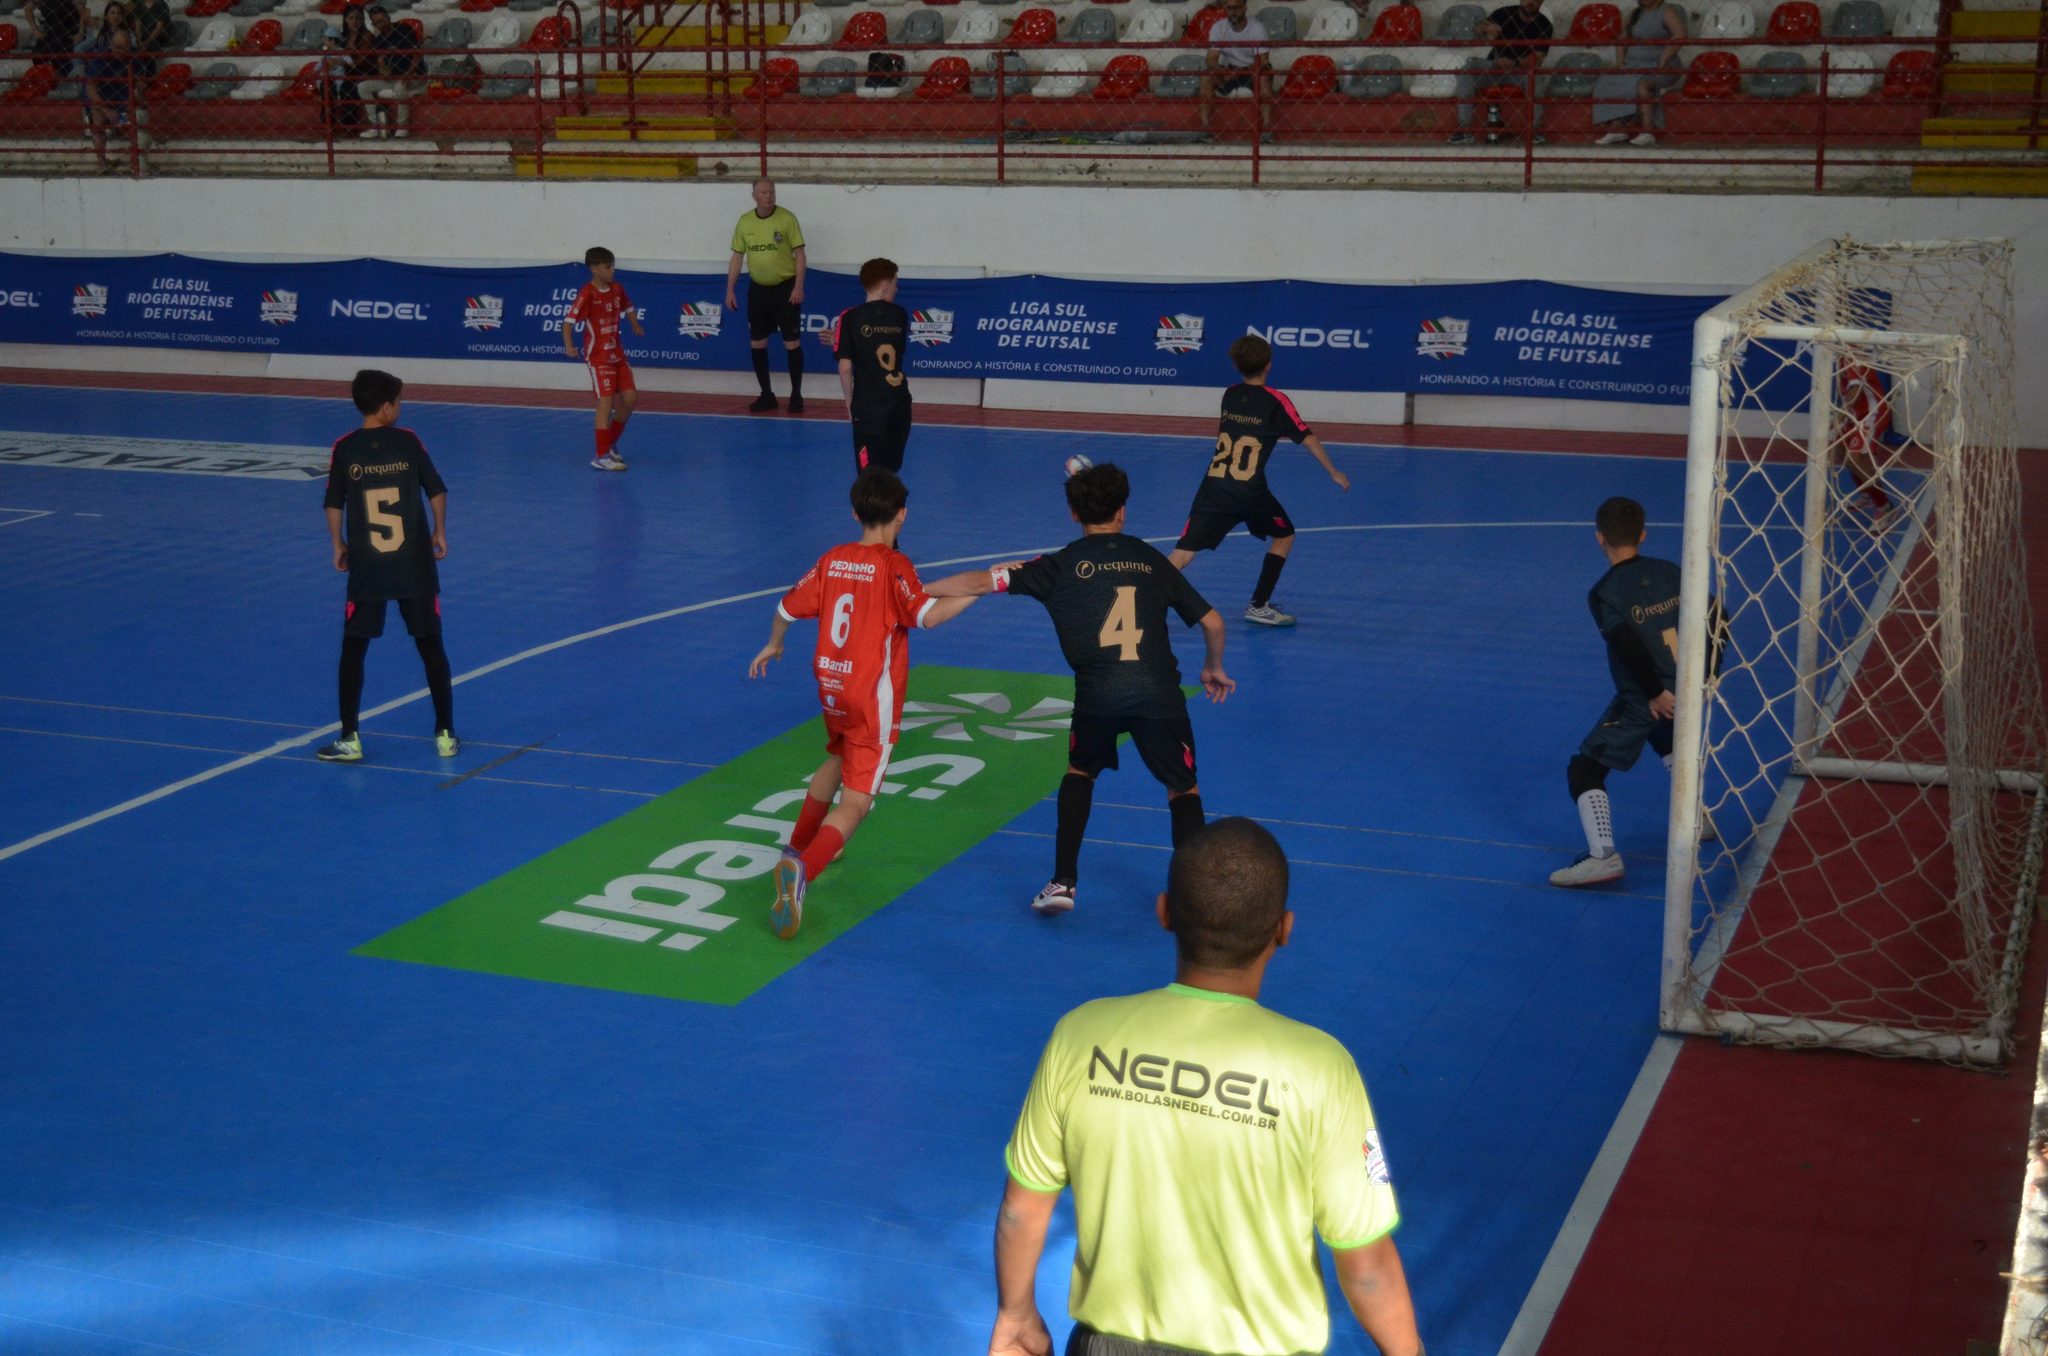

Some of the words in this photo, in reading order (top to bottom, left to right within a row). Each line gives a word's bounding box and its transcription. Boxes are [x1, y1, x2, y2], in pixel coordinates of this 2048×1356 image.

[153, 278, 184, 291] LIGA
[186, 280, 210, 292] SUL
[127, 292, 234, 308] RIOGRANDENSE
[553, 288, 578, 301] LIG
[144, 308, 162, 319] DE
[164, 309, 214, 321] FUTSAL
[331, 299, 428, 321] NEDEL
[1010, 302, 1050, 315] LIGA
[1054, 304, 1087, 317] SUL
[543, 319, 562, 332] DE
[977, 318, 1118, 335] RIOGRANDENSE
[1531, 309, 1576, 327] LIGA
[1581, 314, 1618, 330] SUL
[77, 330, 124, 339] HONRANDO
[126, 331, 132, 339] A
[134, 330, 170, 340] HISTÓRIA
[171, 332, 177, 340] E
[178, 332, 236, 344] CONSTRUINDO
[238, 336, 245, 344] O
[247, 336, 280, 345] FUTURO
[998, 334, 1022, 347] DE
[1024, 335, 1090, 350] FUTSAL
[1246, 325, 1370, 348] NEDEL
[1494, 327, 1653, 348] RIOGRANDENSE
[468, 344, 521, 353] HONRANDO
[651, 350, 659, 359] O
[662, 350, 700, 361] FUTURO
[1518, 346, 1545, 361] DE
[1548, 349, 1622, 365] FUTSAL
[876, 344, 904, 387] 9
[913, 359, 973, 370] HONRANDO
[975, 362, 982, 370] A
[985, 360, 1032, 371] HISTÓRIA
[1035, 363, 1041, 371] E
[1043, 363, 1120, 375] CONSTRUINDO
[1123, 366, 1133, 376] O
[1135, 367, 1177, 377] FUTURO
[1419, 374, 1489, 385] HONRANDO
[1492, 376, 1500, 385] A
[1503, 374, 1555, 388] HISTÓRIA
[1559, 379, 1565, 388] E
[1568, 378, 1654, 394] CONSTRUINDO
[1657, 384, 1667, 395] O
[1671, 384, 1691, 396] FUT
[1208, 432, 1262, 481] 20
[364, 461, 409, 475] requinte
[365, 487, 405, 553] 5
[1098, 560, 1152, 574] requinte
[830, 592, 855, 648] 6
[1099, 586, 1144, 661] 4
[819, 656, 852, 674] Barril
[1088, 1045, 1280, 1117] NEDEL
[1088, 1083, 1278, 1131] WWW.BOLASNEDEL.COM.BR
